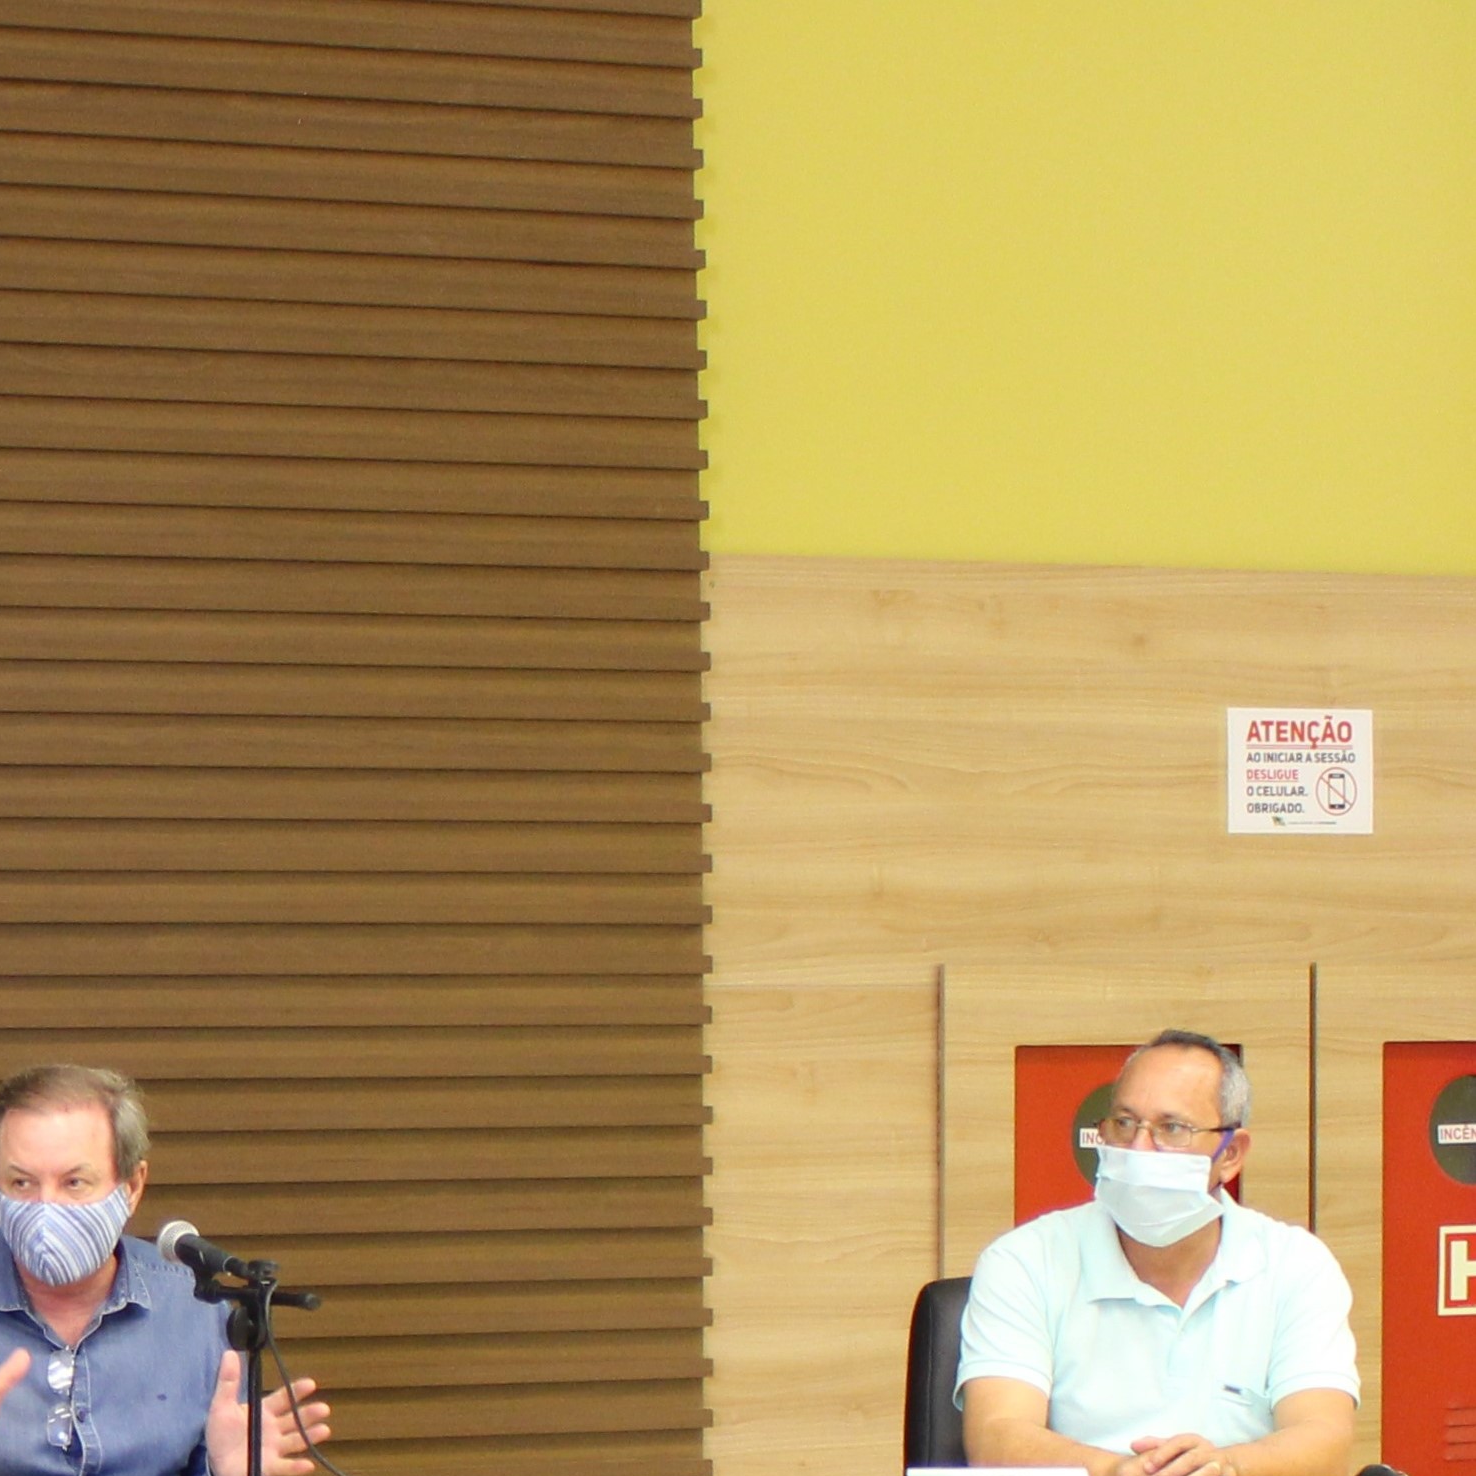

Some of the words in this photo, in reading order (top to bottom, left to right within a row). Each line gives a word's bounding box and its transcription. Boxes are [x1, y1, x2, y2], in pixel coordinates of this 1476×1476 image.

[1246, 715, 1353, 749] ATENÇÃO
[1246, 752, 1261, 763] AO
[1263, 752, 1302, 763] INICIAR
[1304, 752, 1313, 763] A
[1315, 750, 1355, 763] SESSÃO
[1246, 769, 1299, 780] DESLIGUE
[1246, 785, 1254, 796] O
[1256, 785, 1308, 796] CELULAR.
[1246, 802, 1305, 813] OBRIGADO.
